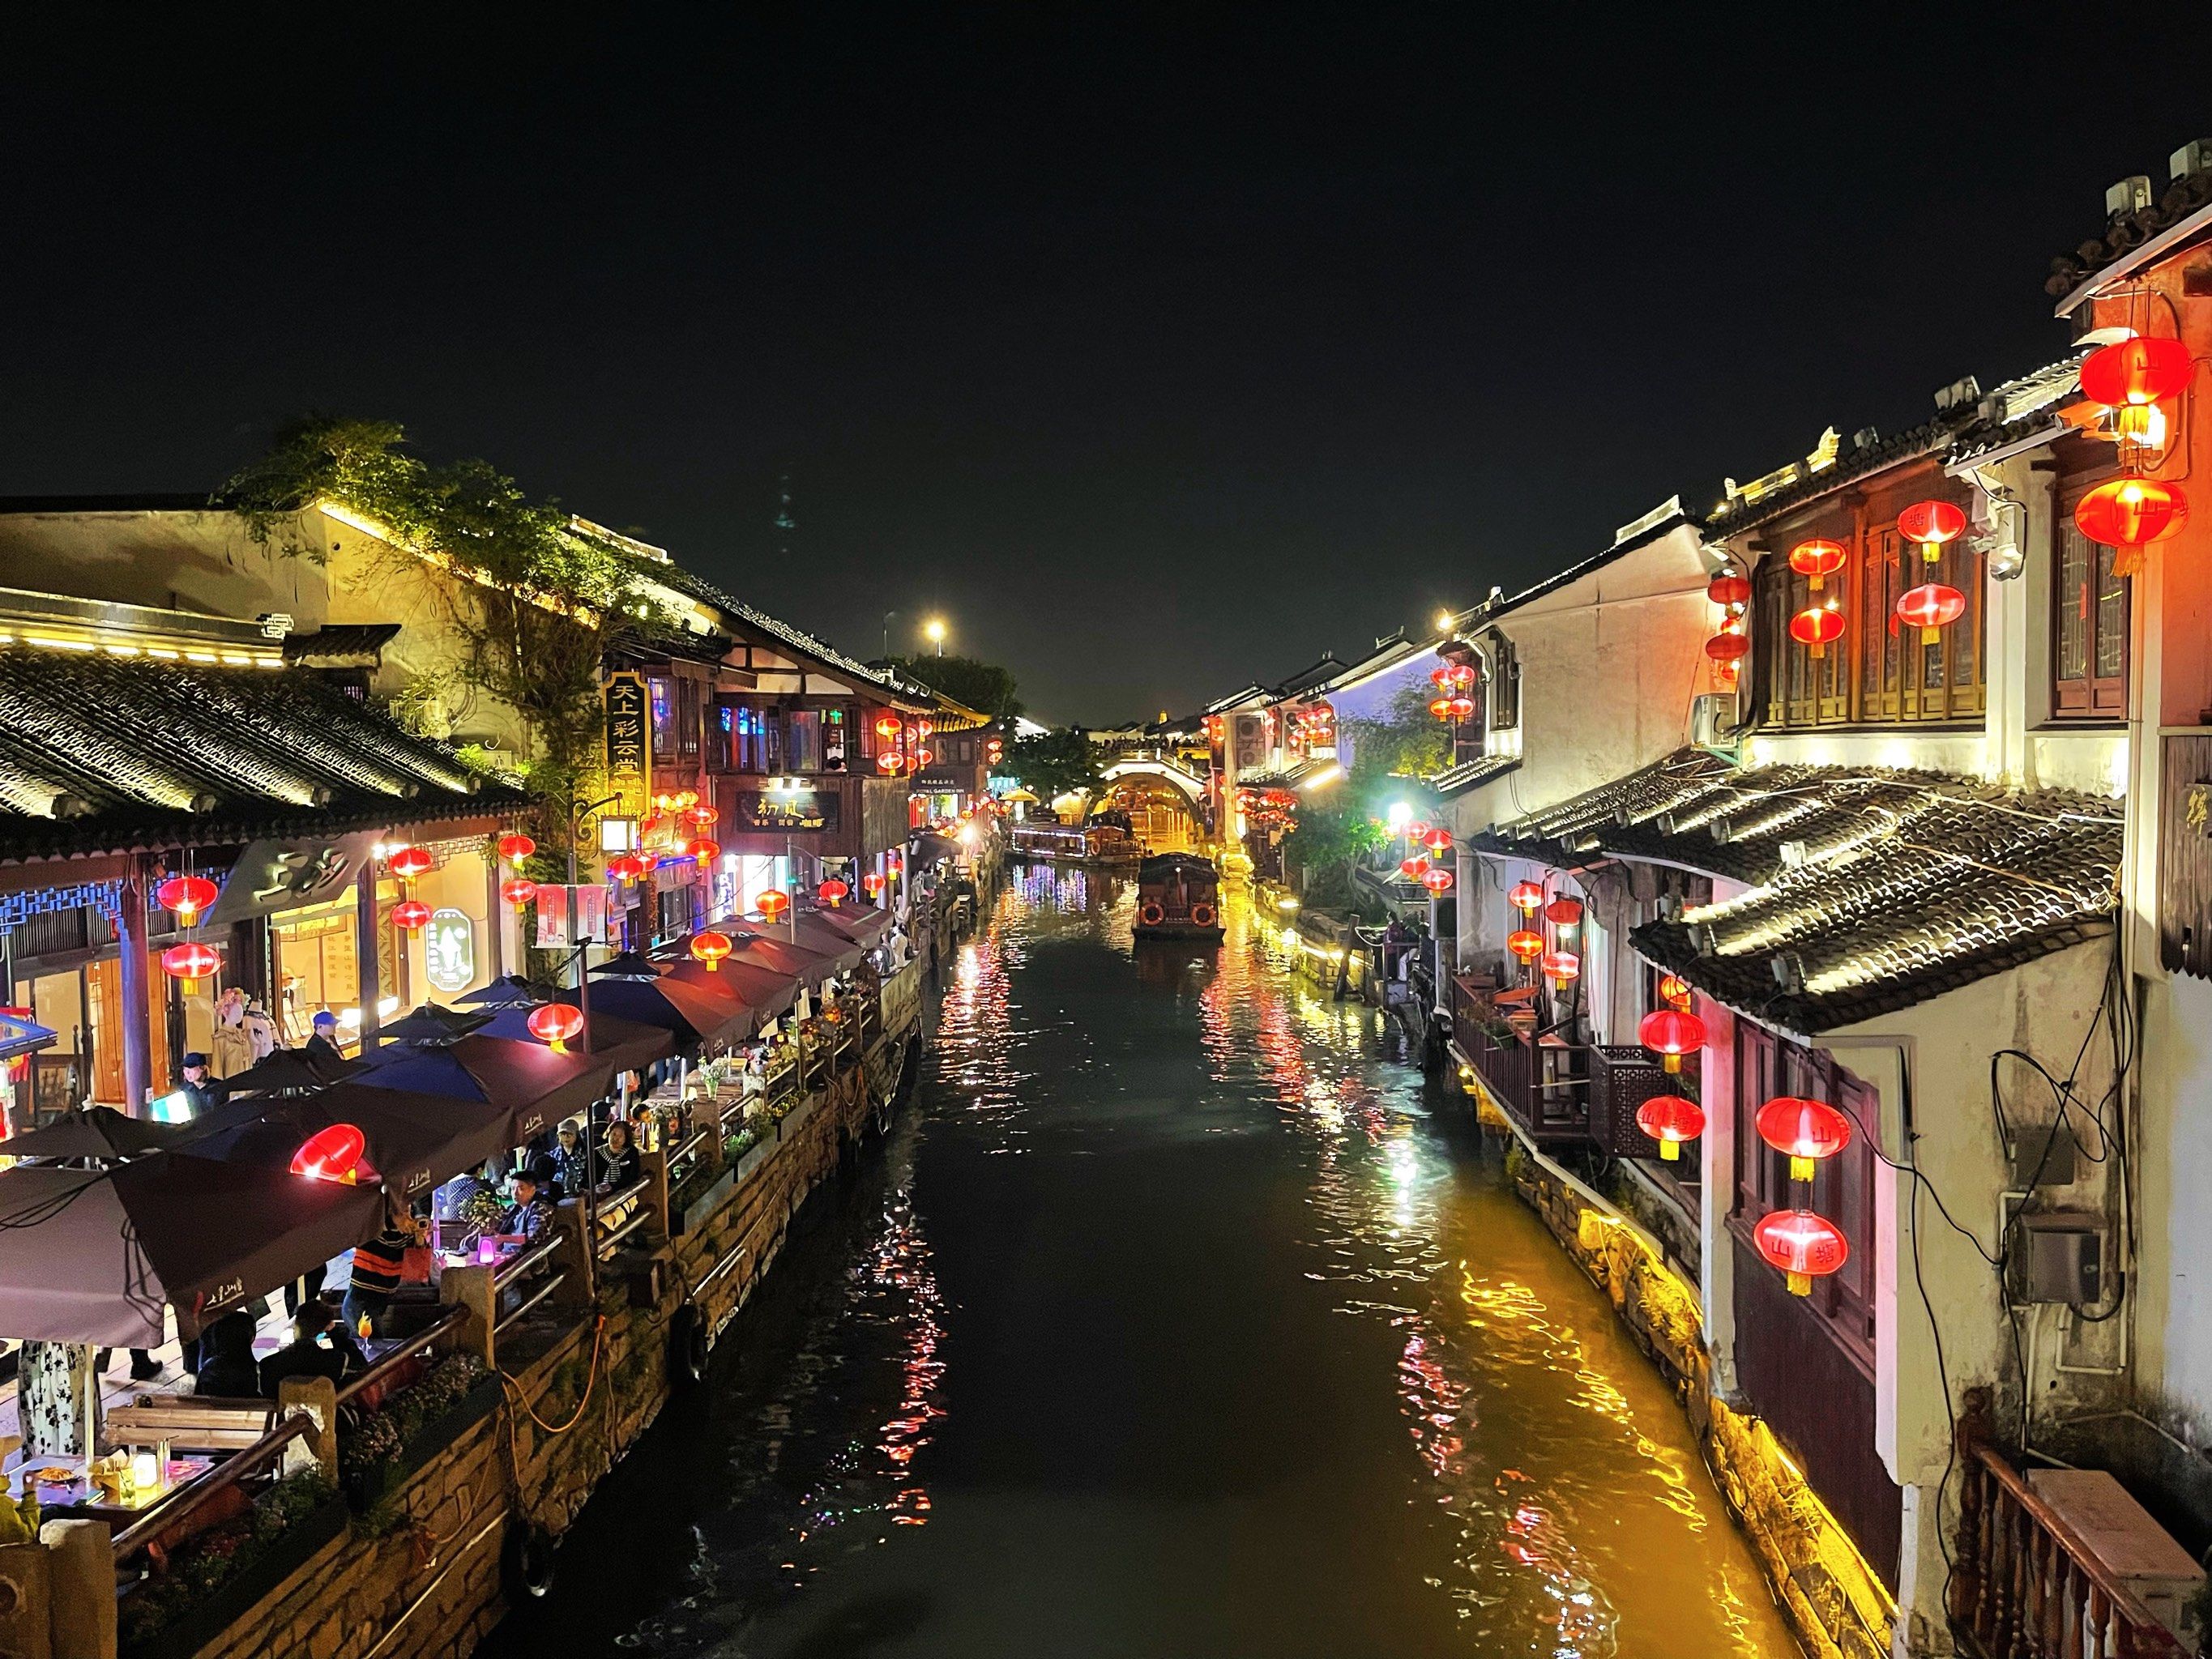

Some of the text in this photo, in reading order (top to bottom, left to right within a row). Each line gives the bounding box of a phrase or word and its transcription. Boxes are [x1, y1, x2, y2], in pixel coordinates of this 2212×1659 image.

[612, 684, 640, 777] 天上彩云堂
